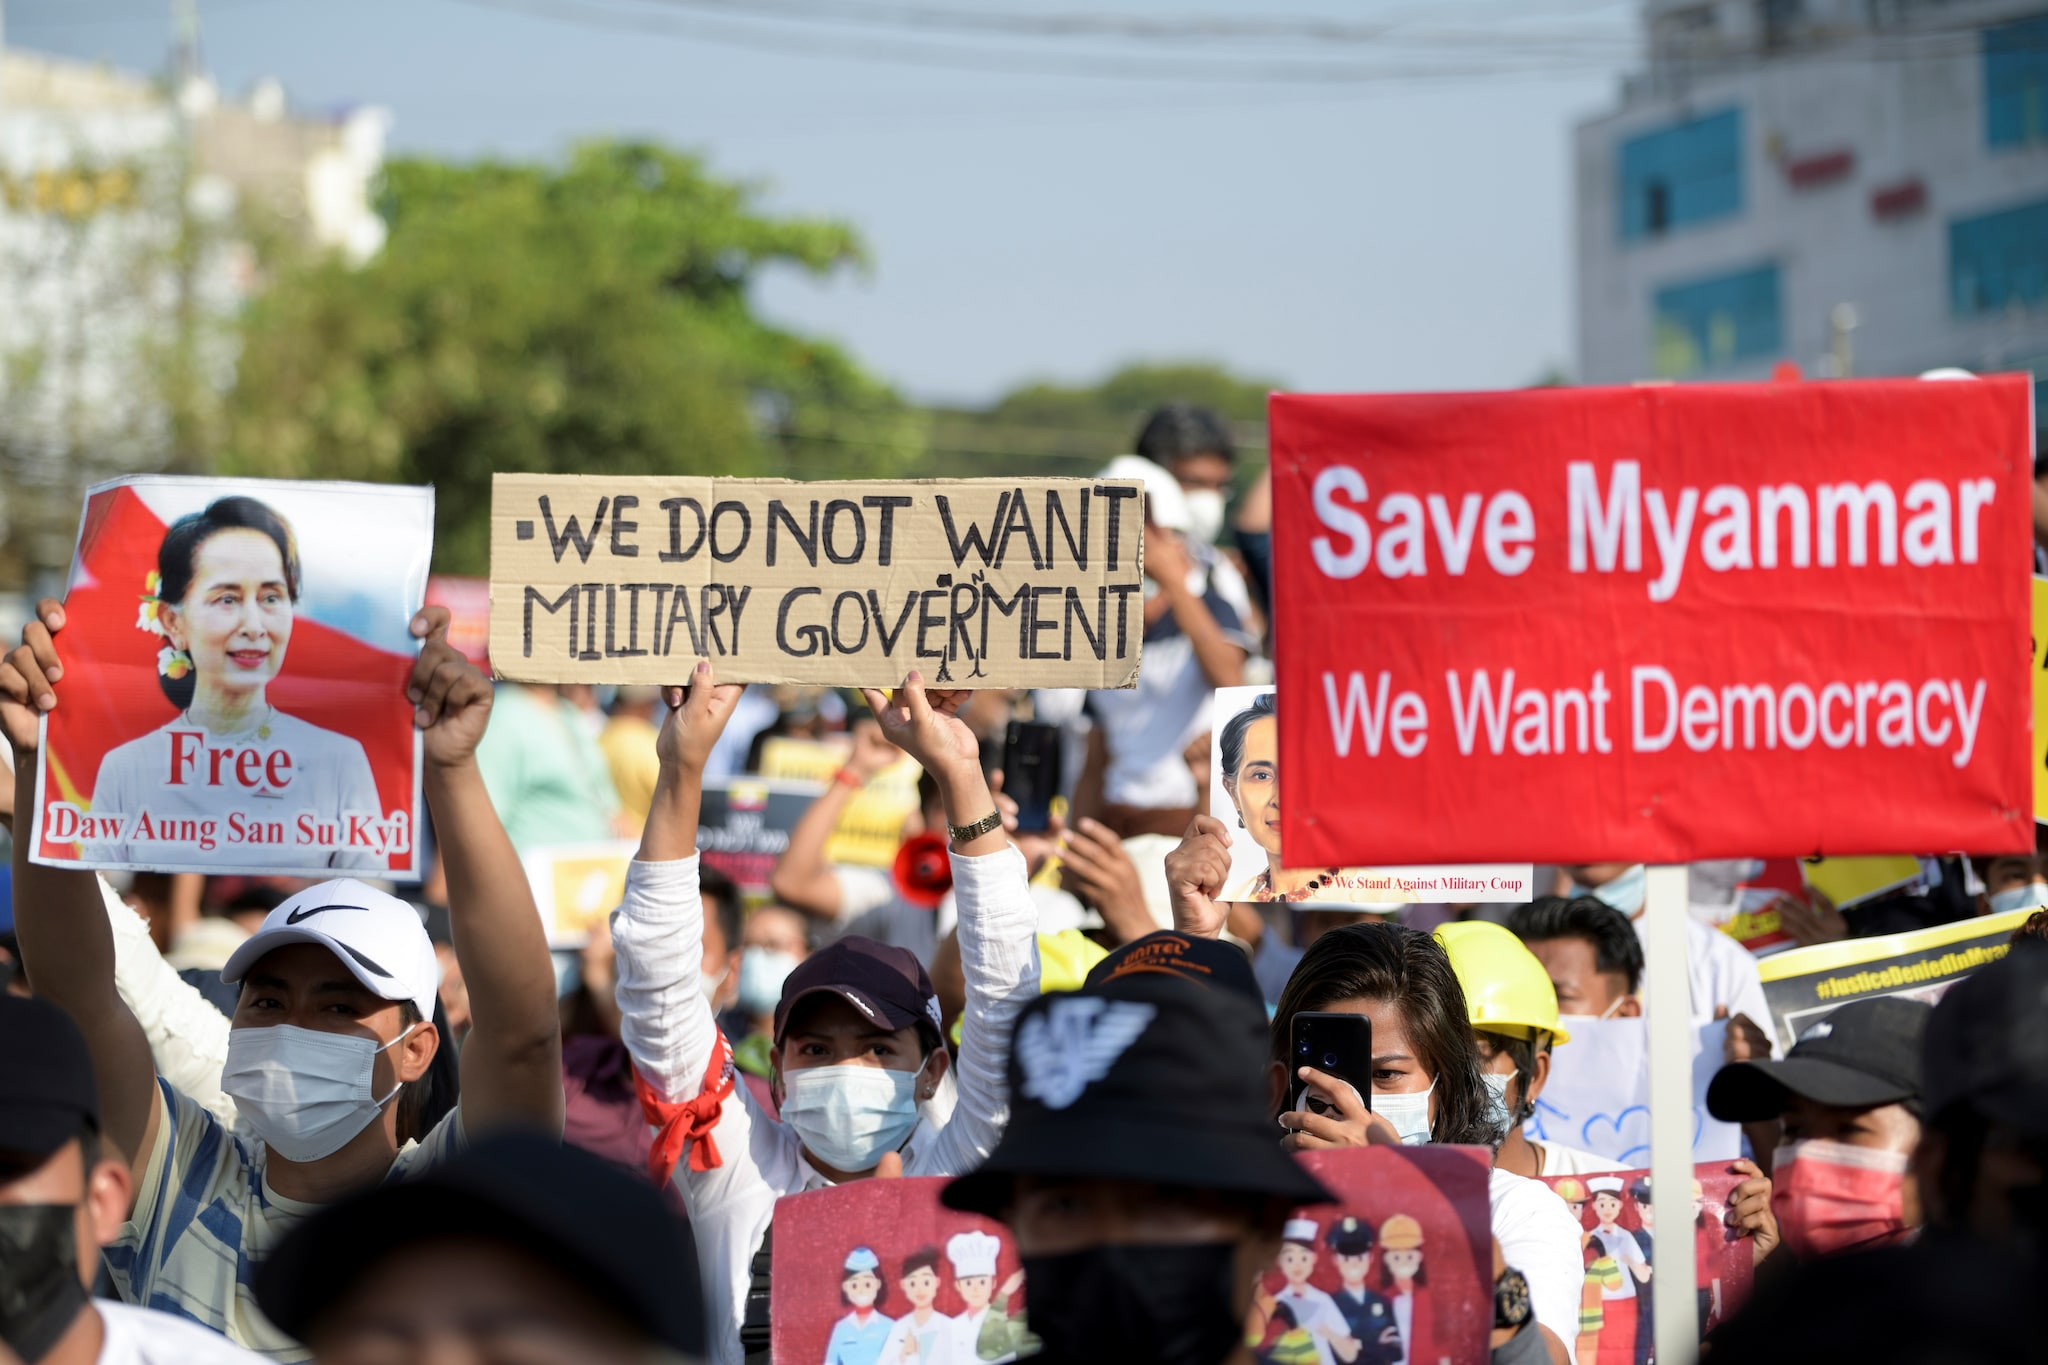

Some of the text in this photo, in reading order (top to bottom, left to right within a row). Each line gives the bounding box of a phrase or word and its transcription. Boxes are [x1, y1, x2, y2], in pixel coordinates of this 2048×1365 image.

[658, 497, 752, 563] DO
[766, 495, 913, 567] NOT
[934, 484, 1139, 572] WANT
[1311, 460, 1996, 602] Save Myanmar
[523, 582, 751, 661] MILITARY
[1323, 672, 1428, 757] We
[1446, 669, 1612, 755] Want
[1632, 666, 1986, 767] Democracy
[164, 731, 293, 788] Free
[53, 807, 403, 856] Daw Aung San Su Kyi
[1357, 876, 1391, 890] Stand
[1394, 876, 1438, 892] Against
[1441, 876, 1488, 893] Military
[1490, 876, 1523, 894] Coup
